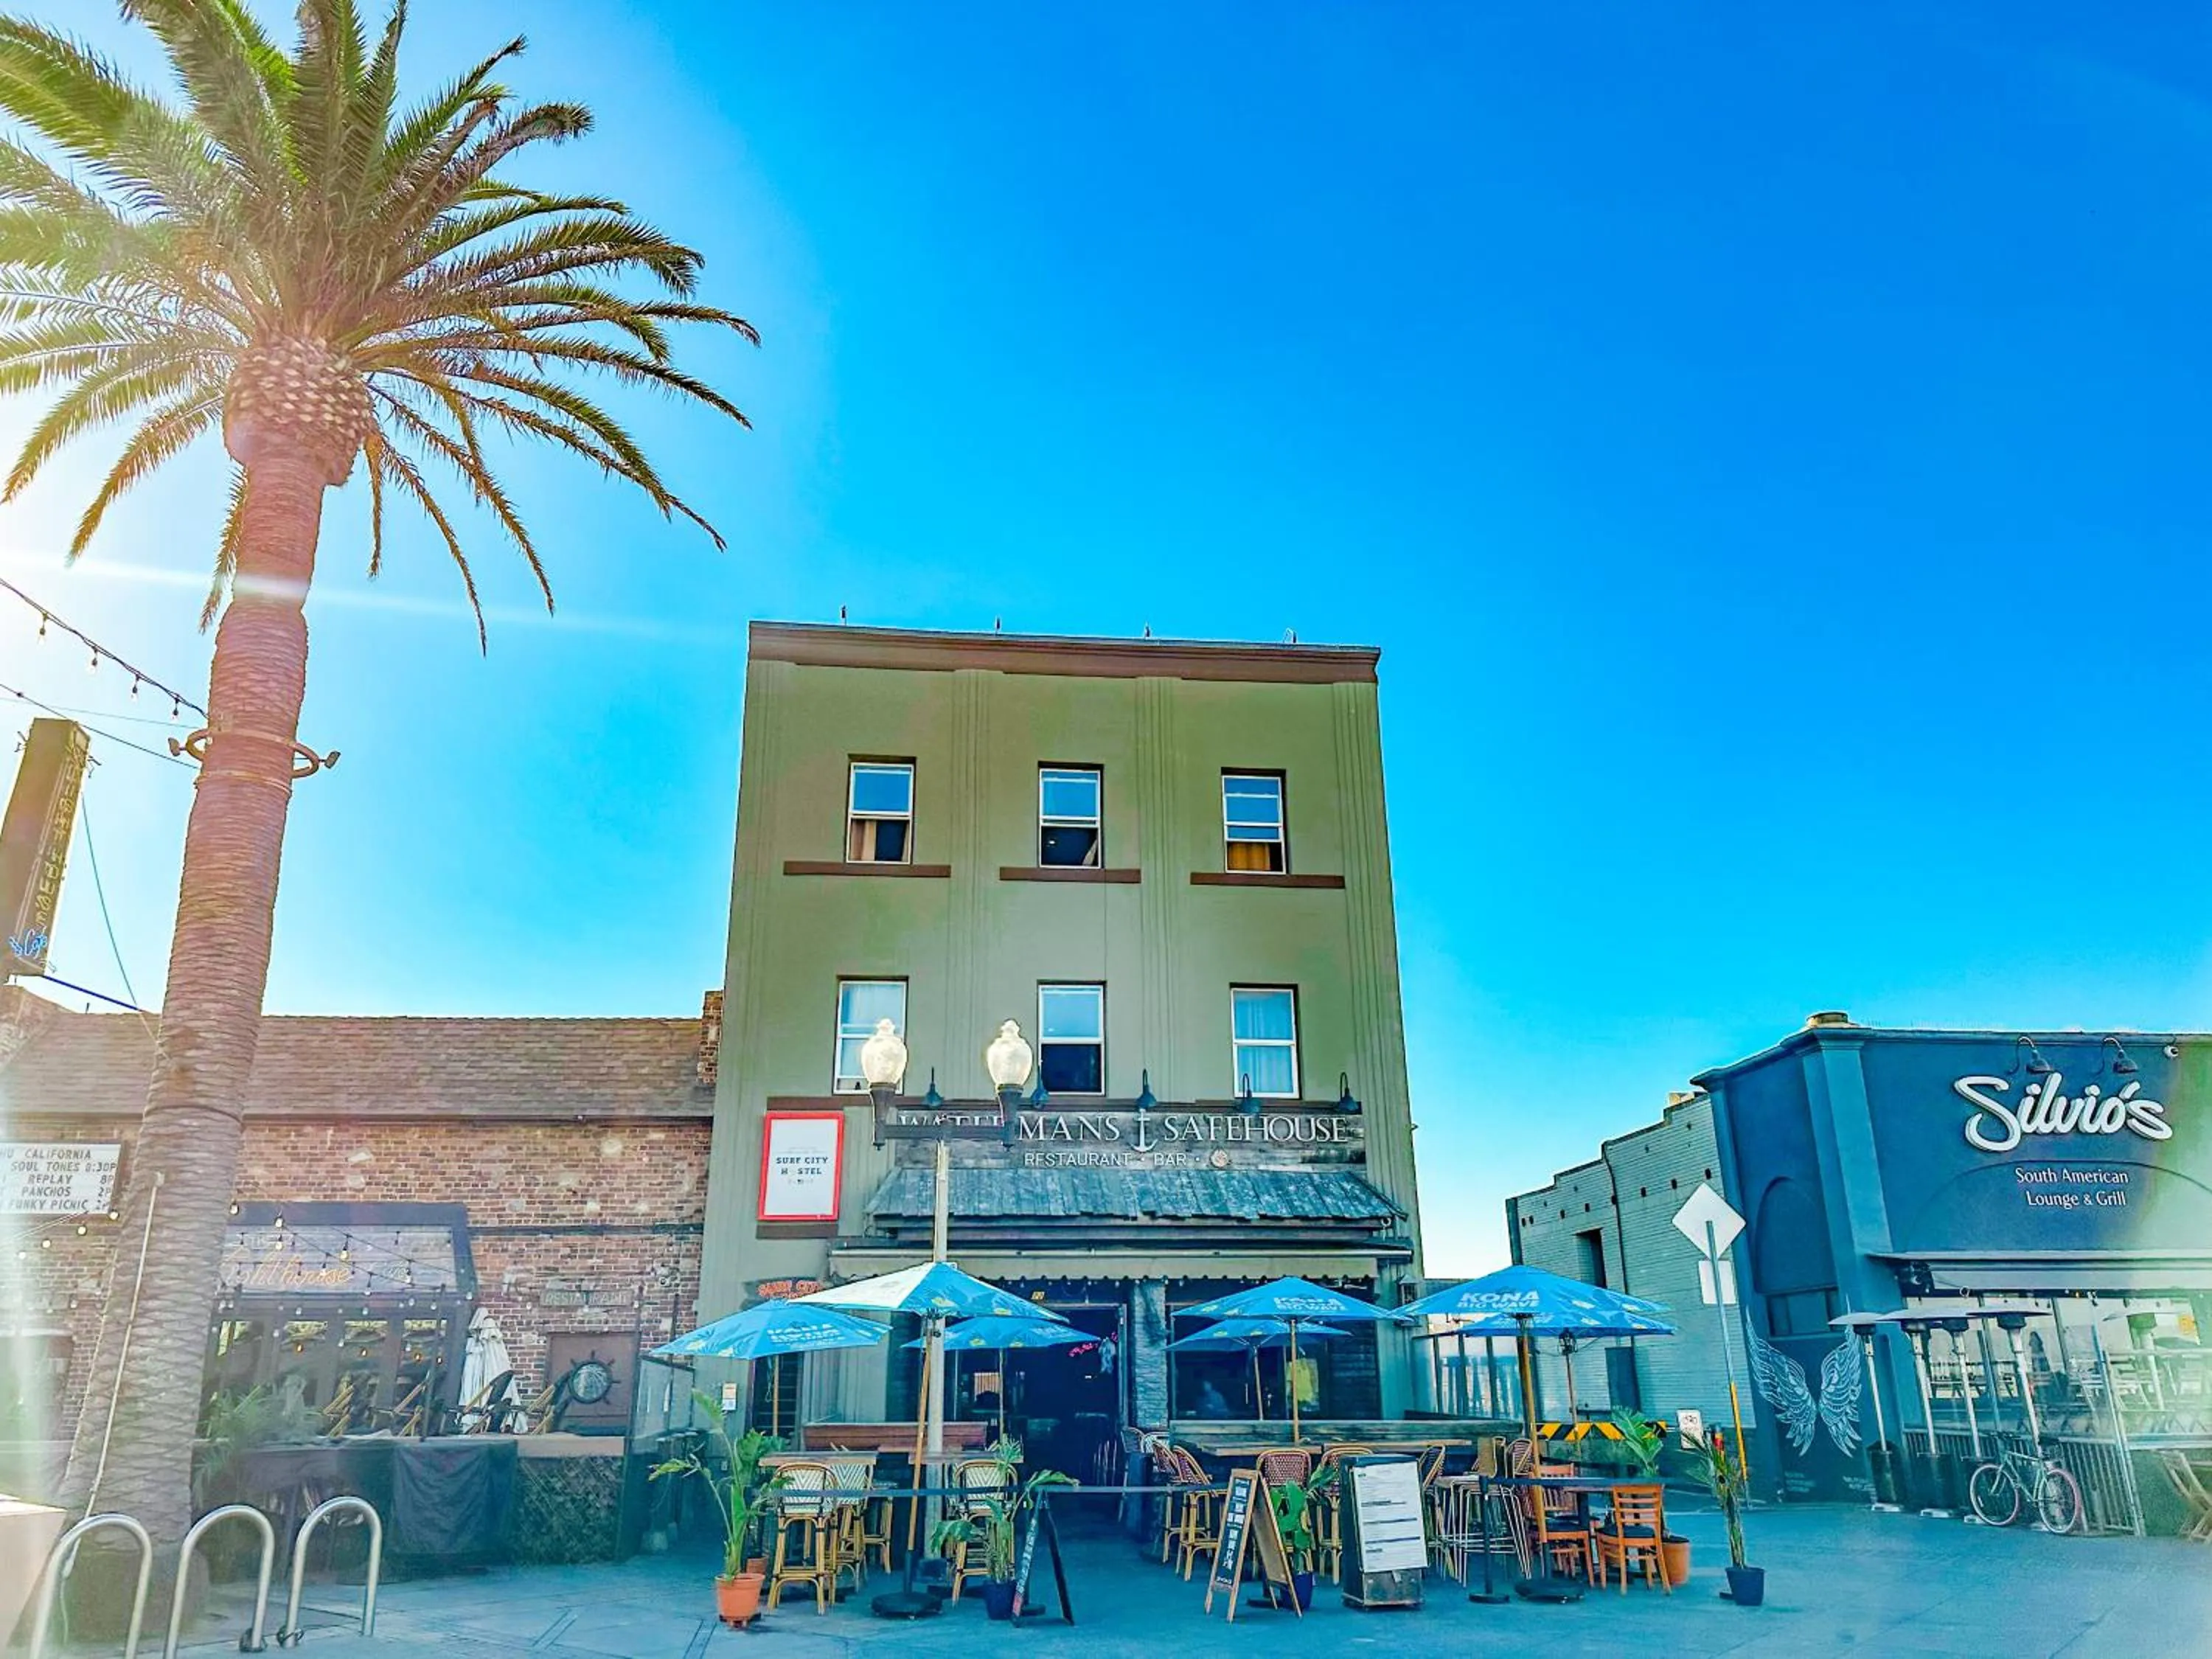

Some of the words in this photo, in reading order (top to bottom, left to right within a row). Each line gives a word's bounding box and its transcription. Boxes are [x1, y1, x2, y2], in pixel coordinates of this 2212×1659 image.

[1164, 1116, 1349, 1142] SAFEHOUSE
[25, 1148, 91, 1159] CALIFORNIA
[1024, 1152, 1133, 1166] RESTAURANT
[1154, 1152, 1187, 1166] BAR
[804, 1156, 829, 1164] CITY
[11, 1161, 39, 1172] SOUL
[46, 1161, 80, 1172] TONES
[27, 1174, 73, 1184] REPLAY
[2015, 1167, 2058, 1183] South
[2062, 1168, 2129, 1183] American
[21, 1186, 72, 1197] PANCHOS
[8, 1199, 46, 1210] FUNKY
[50, 1199, 88, 1210] PICNIC
[2026, 1191, 2079, 1210] Lounge
[2083, 1193, 2093, 1206] &
[2096, 1191, 2126, 1206] Grill
[1460, 1290, 1540, 1303] KONA
